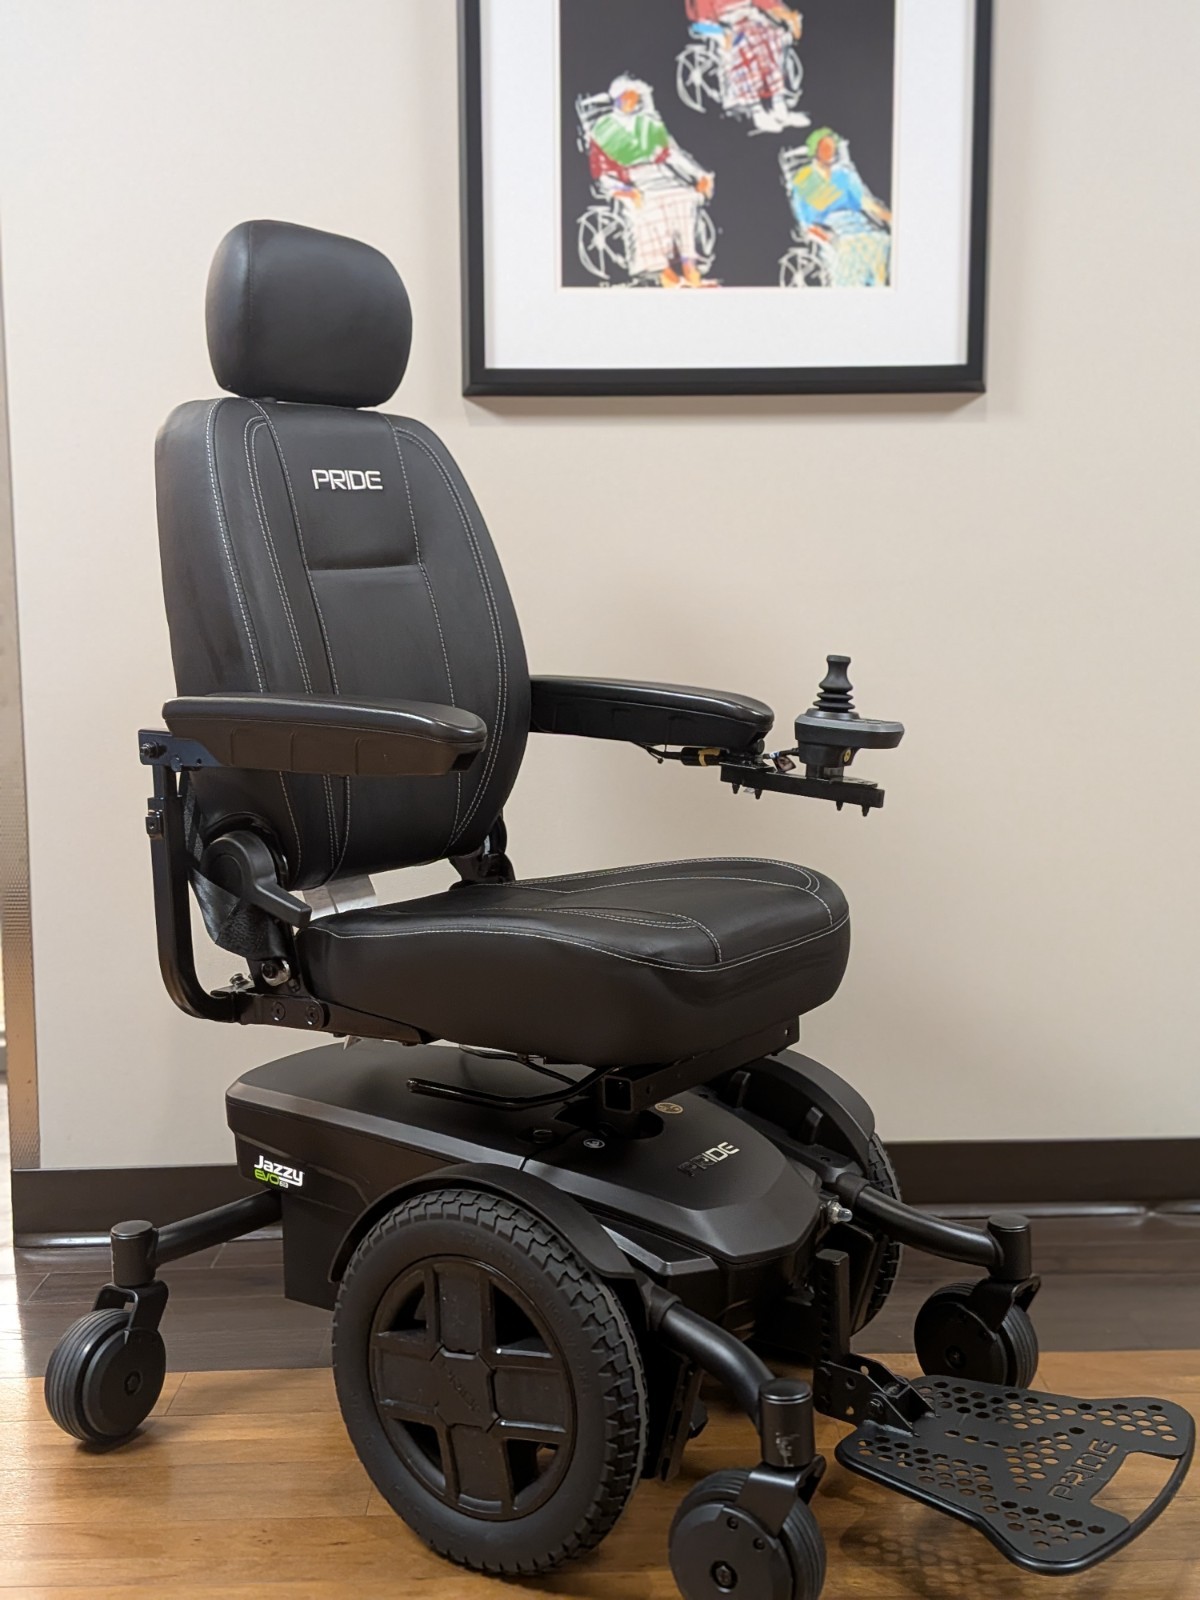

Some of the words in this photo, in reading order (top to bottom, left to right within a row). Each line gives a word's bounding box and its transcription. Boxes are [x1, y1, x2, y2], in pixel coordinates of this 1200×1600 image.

[311, 469, 384, 491] PRIDE
[253, 1154, 304, 1187] Jazzy
[677, 1141, 740, 1177] PRIDE
[1047, 1437, 1119, 1501] PRIDE
